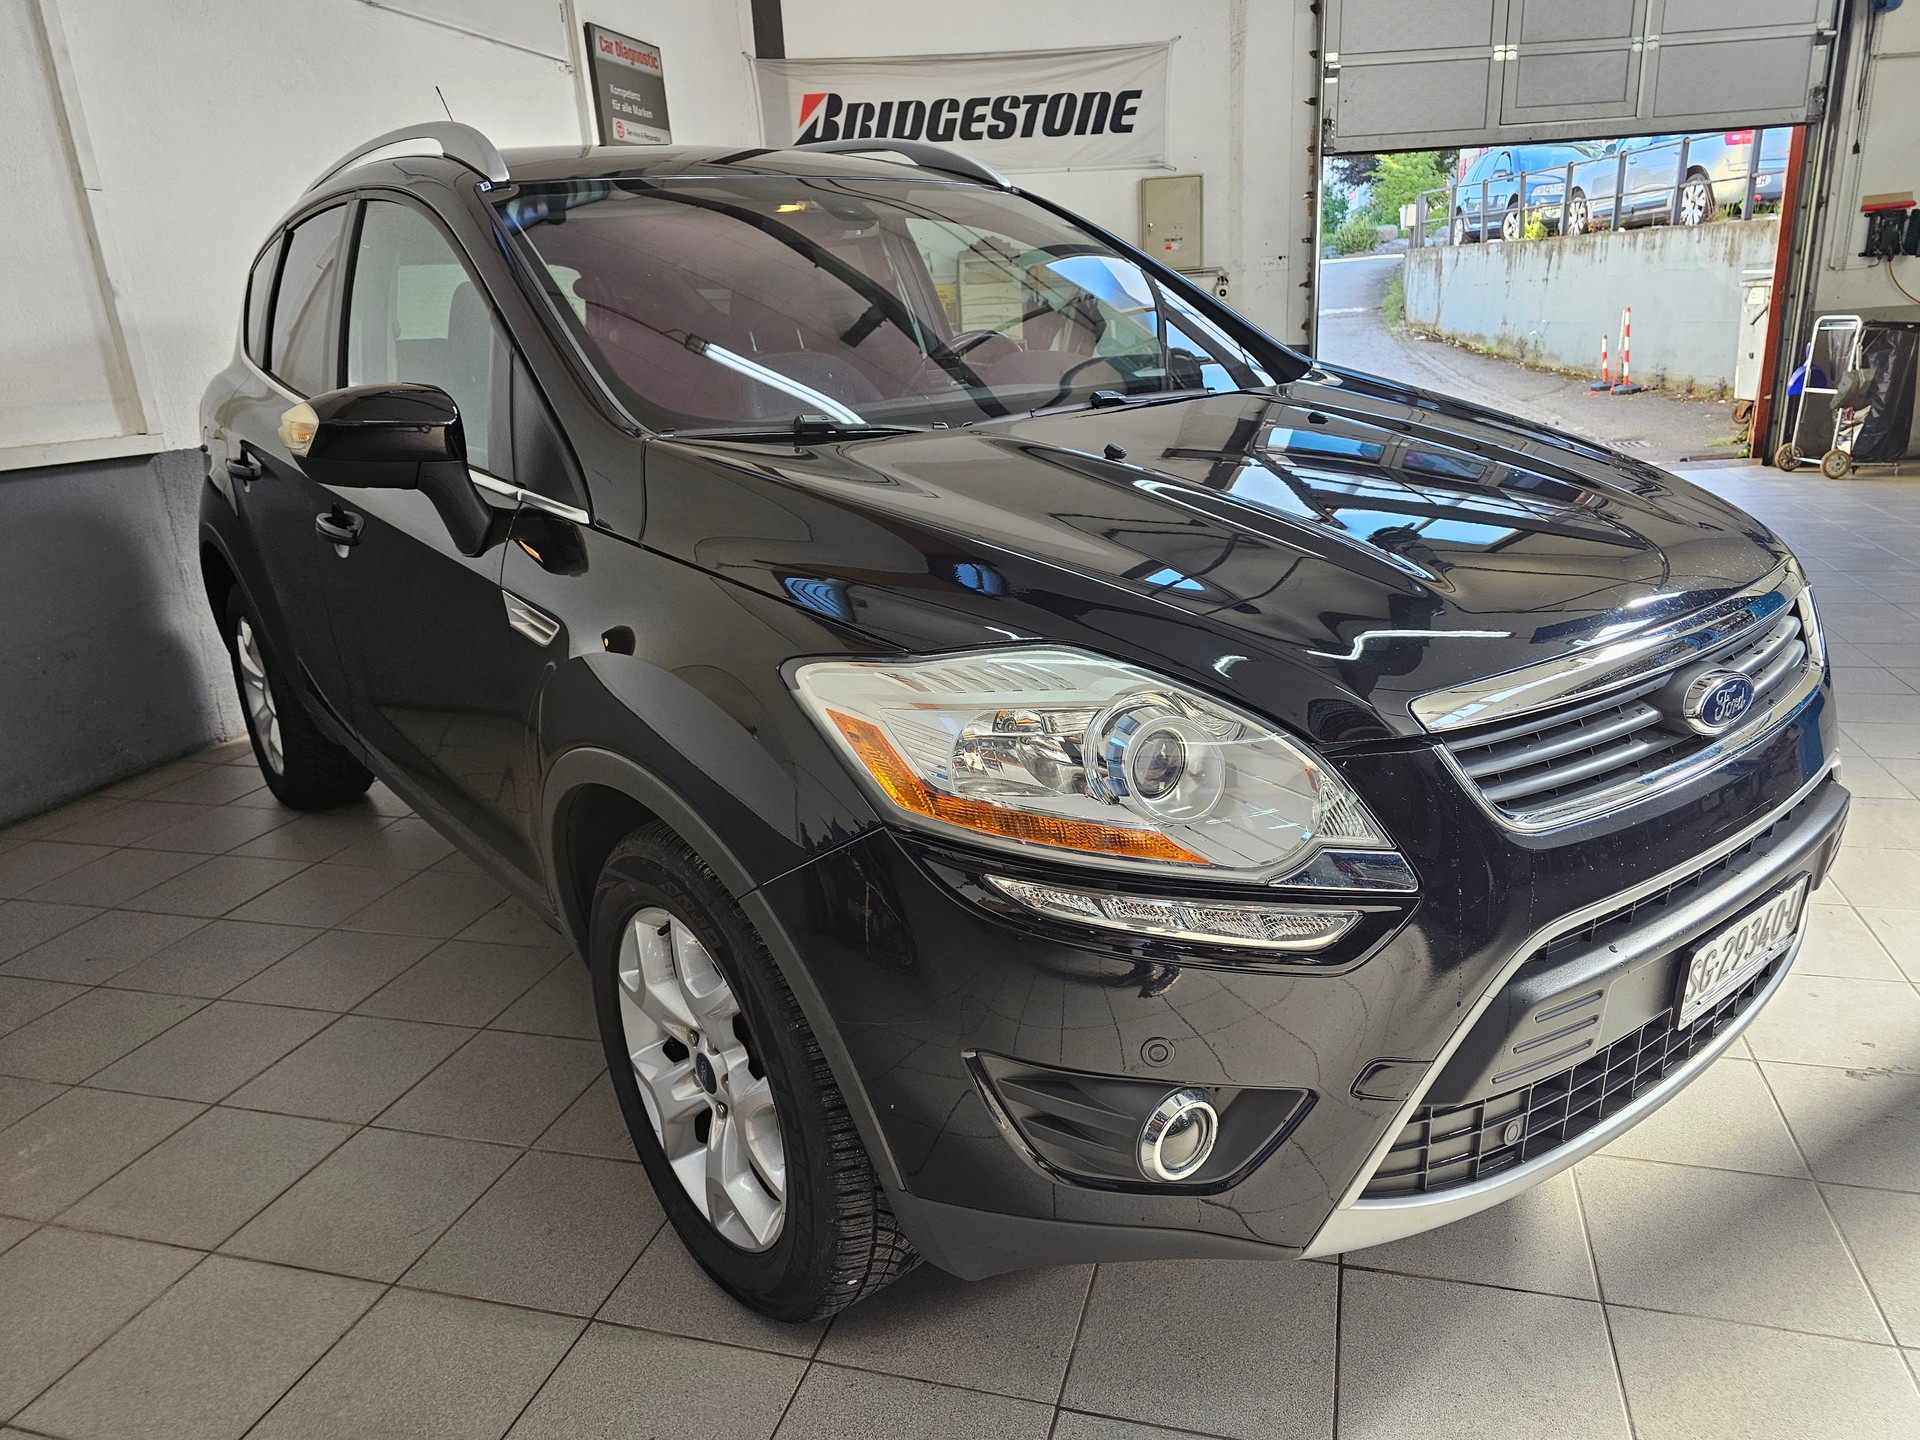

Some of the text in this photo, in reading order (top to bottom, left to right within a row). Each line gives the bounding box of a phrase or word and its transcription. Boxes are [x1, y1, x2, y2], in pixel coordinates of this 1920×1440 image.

[598, 35, 659, 70] Car Diagnostic
[793, 89, 1143, 146] BRIDGESTONE
[1714, 684, 1746, 721] Ford
